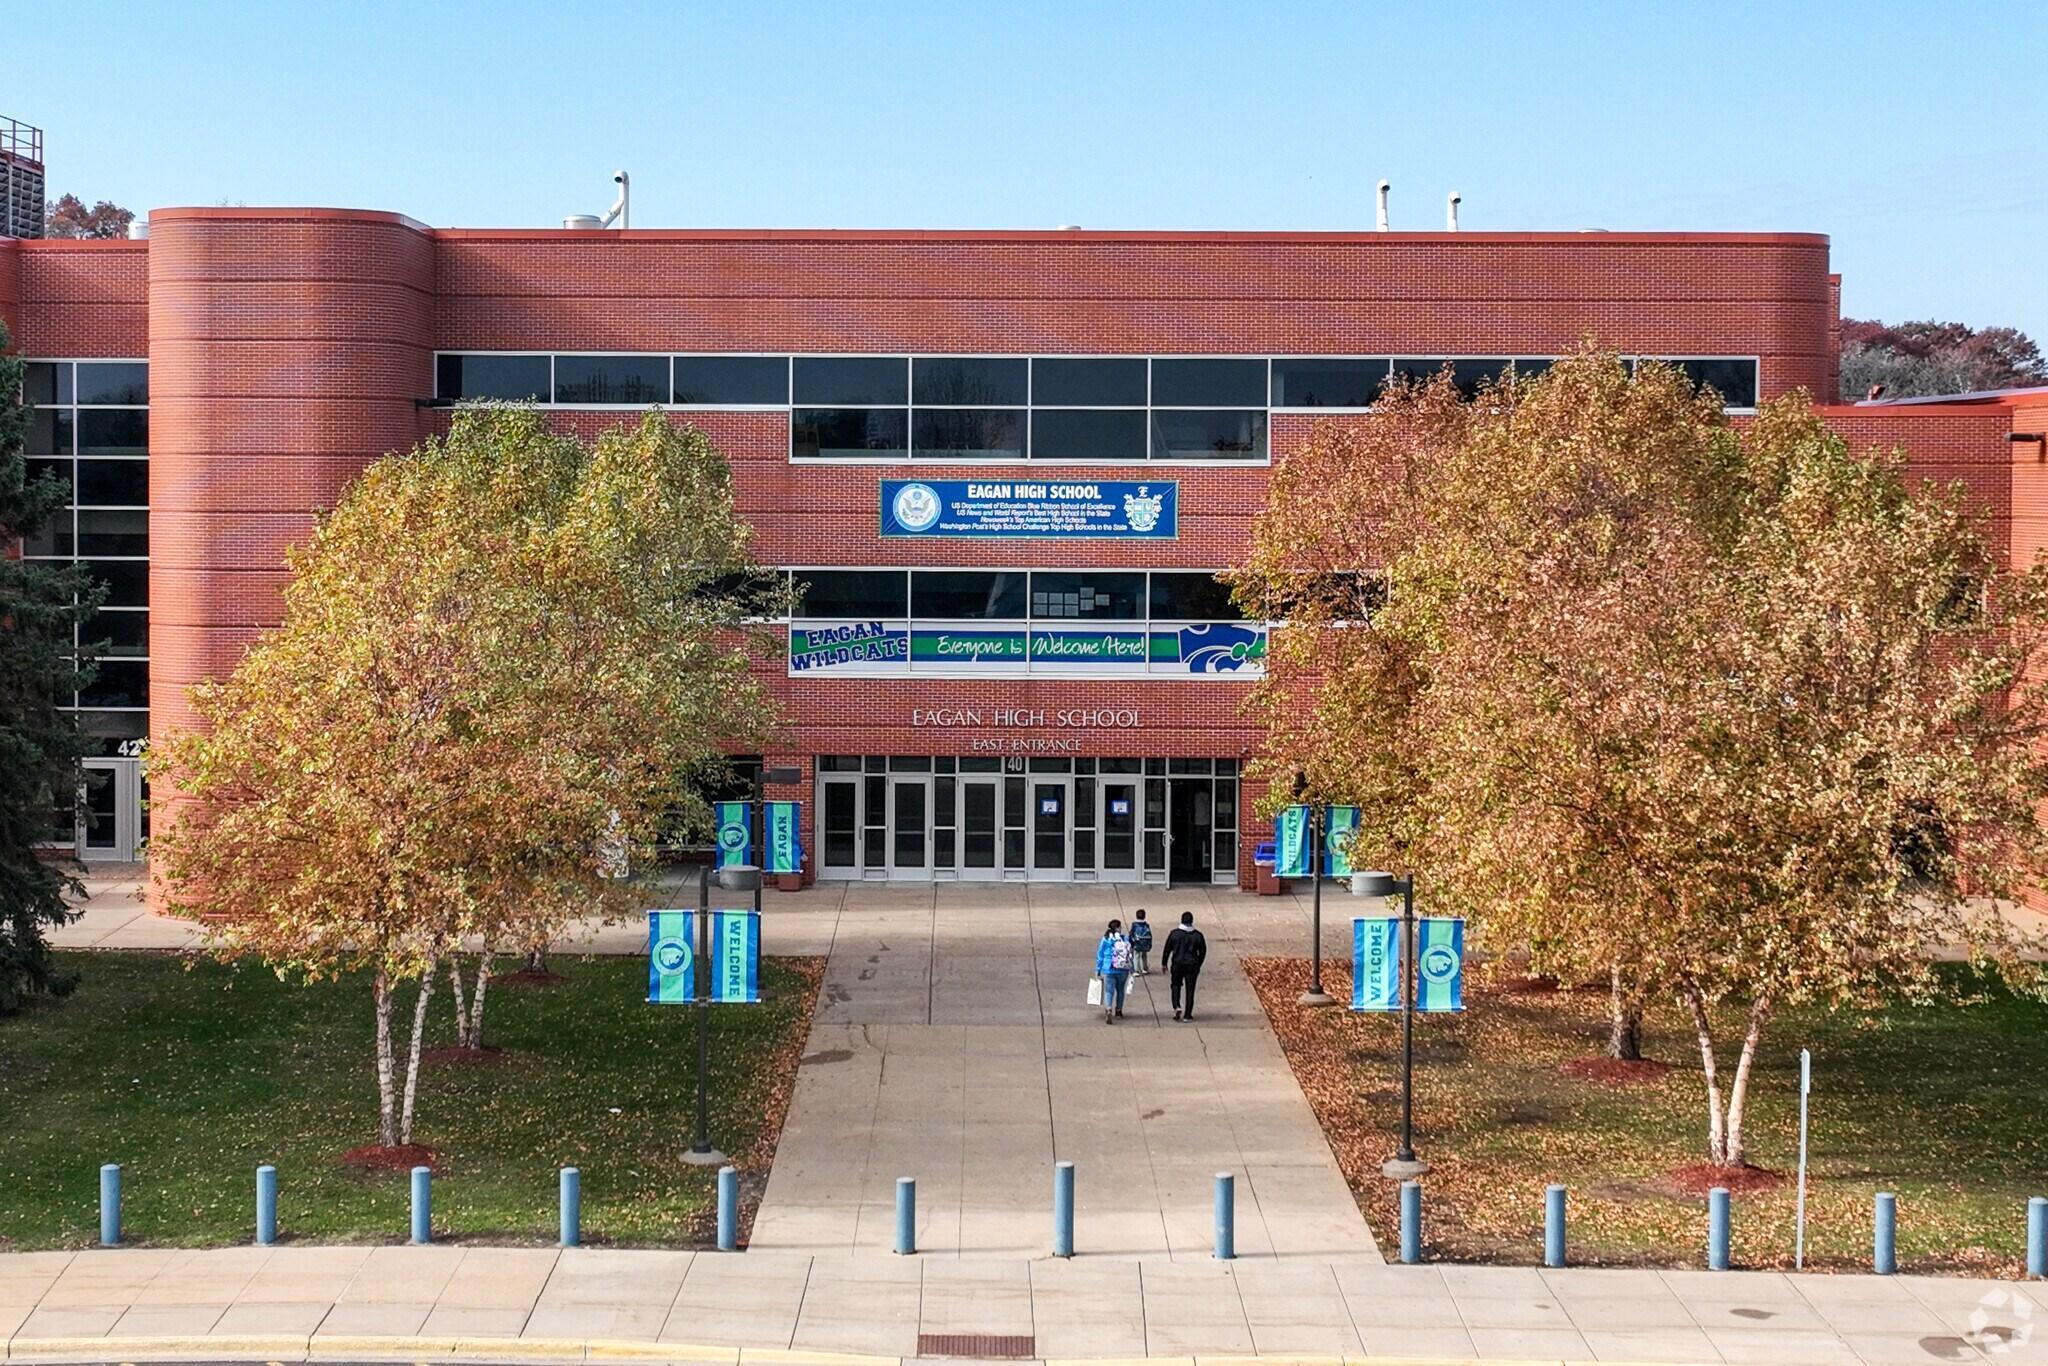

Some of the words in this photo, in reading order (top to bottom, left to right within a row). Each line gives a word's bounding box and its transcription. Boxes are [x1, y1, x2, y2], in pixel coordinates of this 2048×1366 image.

[968, 485, 1011, 498] EAGAN
[1015, 485, 1047, 498] HIGH
[1050, 485, 1102, 499] SCHOOL
[807, 622, 886, 648] EAGAN
[937, 636, 1003, 662] Everyone
[1032, 633, 1099, 656] Welcome
[1105, 634, 1145, 656] Here!
[791, 637, 908, 670] WILDCATS
[912, 709, 982, 727] EAGAN
[995, 709, 1045, 727] HIGH
[1056, 709, 1144, 727] SCHOOL
[972, 738, 1003, 751] EAST
[1012, 738, 1082, 751] ENTRANCE
[1007, 757, 1023, 773] 40
[779, 816, 787, 859] EAGAN
[730, 920, 741, 996] WELCOME
[1370, 924, 1382, 1001] WELCOME
